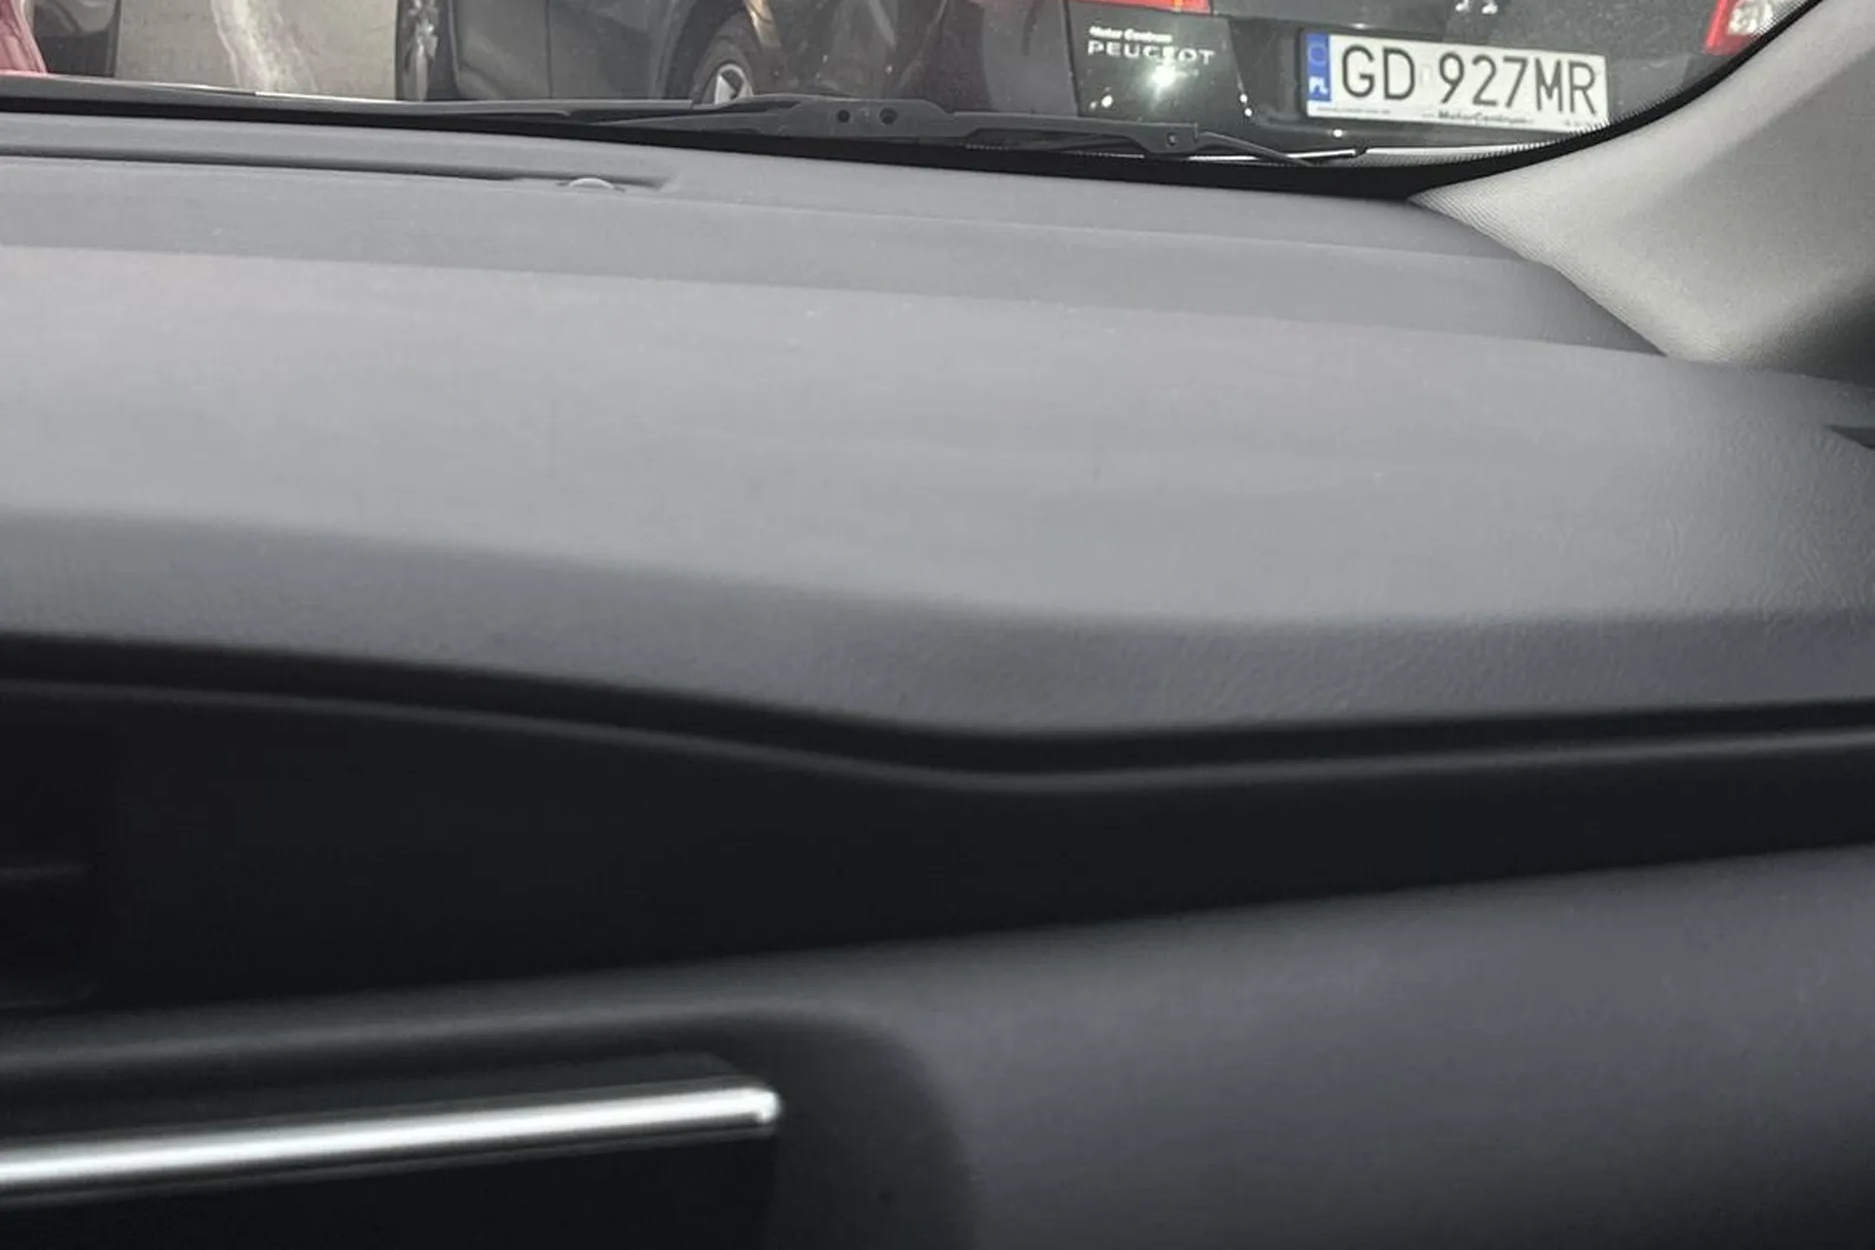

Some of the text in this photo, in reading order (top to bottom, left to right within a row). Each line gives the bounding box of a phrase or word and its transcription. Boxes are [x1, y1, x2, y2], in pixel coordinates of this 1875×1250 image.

[1308, 76, 1329, 95] PL
[1341, 44, 1597, 115] GD 927MR
